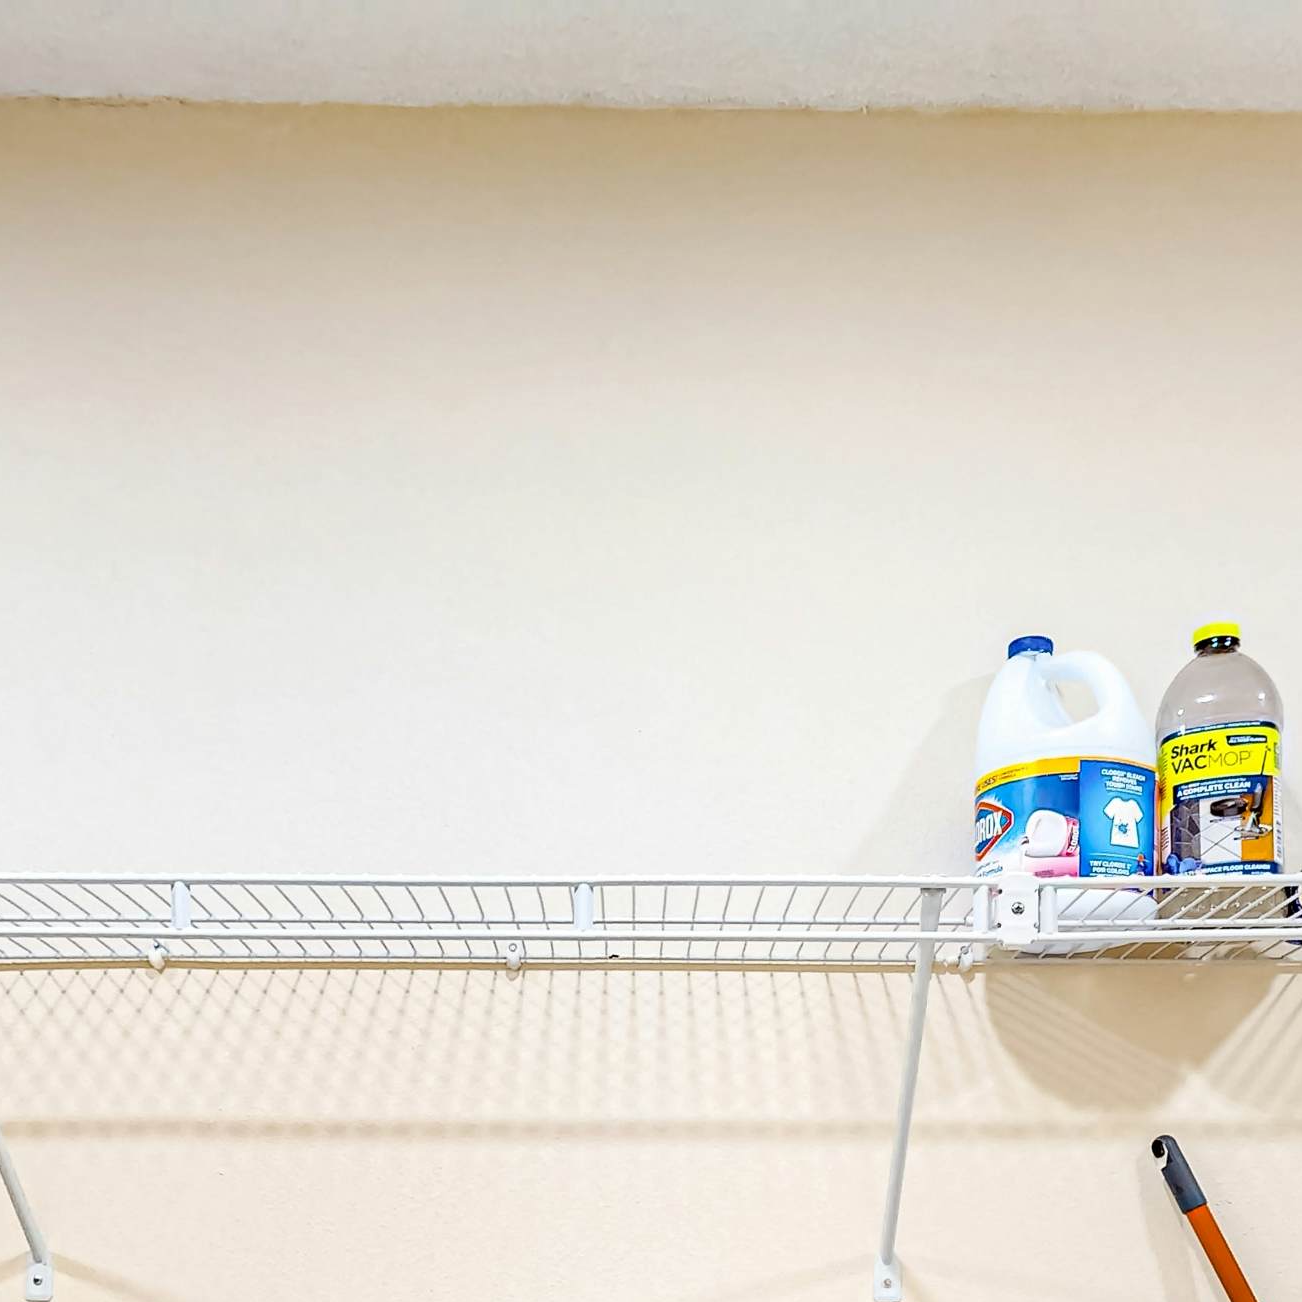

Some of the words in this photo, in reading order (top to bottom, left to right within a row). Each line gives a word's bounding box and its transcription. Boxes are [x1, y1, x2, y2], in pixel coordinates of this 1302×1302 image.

[1171, 739, 1218, 759] Shark
[1171, 751, 1251, 774] VACMOP
[1183, 784, 1224, 796] COMPLETE
[1224, 782, 1251, 790] CLEAN
